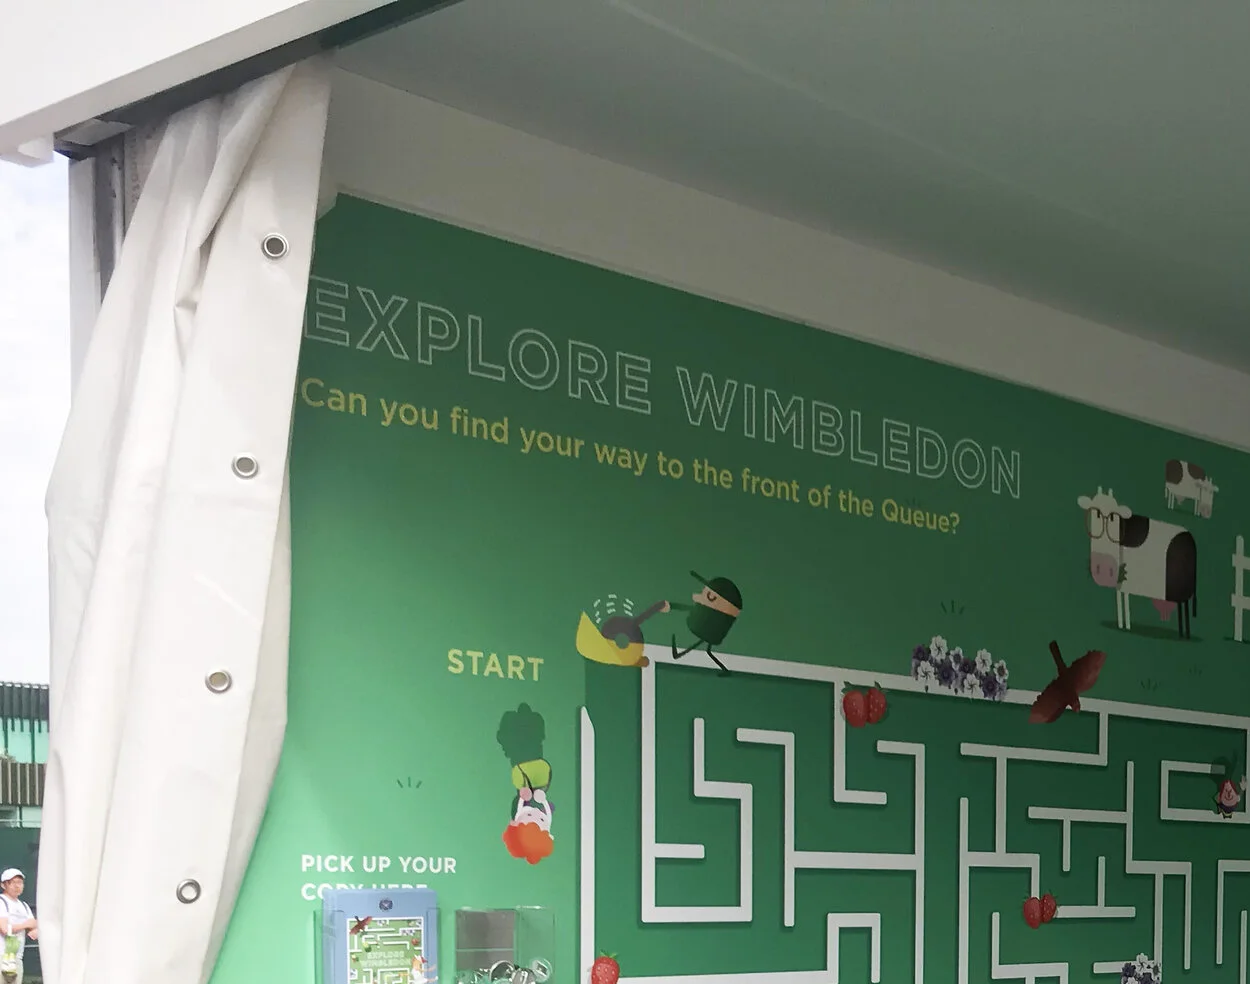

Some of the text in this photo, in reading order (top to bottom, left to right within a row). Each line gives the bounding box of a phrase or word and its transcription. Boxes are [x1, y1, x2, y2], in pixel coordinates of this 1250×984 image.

[303, 275, 1020, 499] EXPLORE WIMBLEDON
[301, 377, 960, 535] Can you find your way to the front of the Queue?
[447, 648, 545, 681] START
[301, 855, 457, 874] PICK UP YOUR
